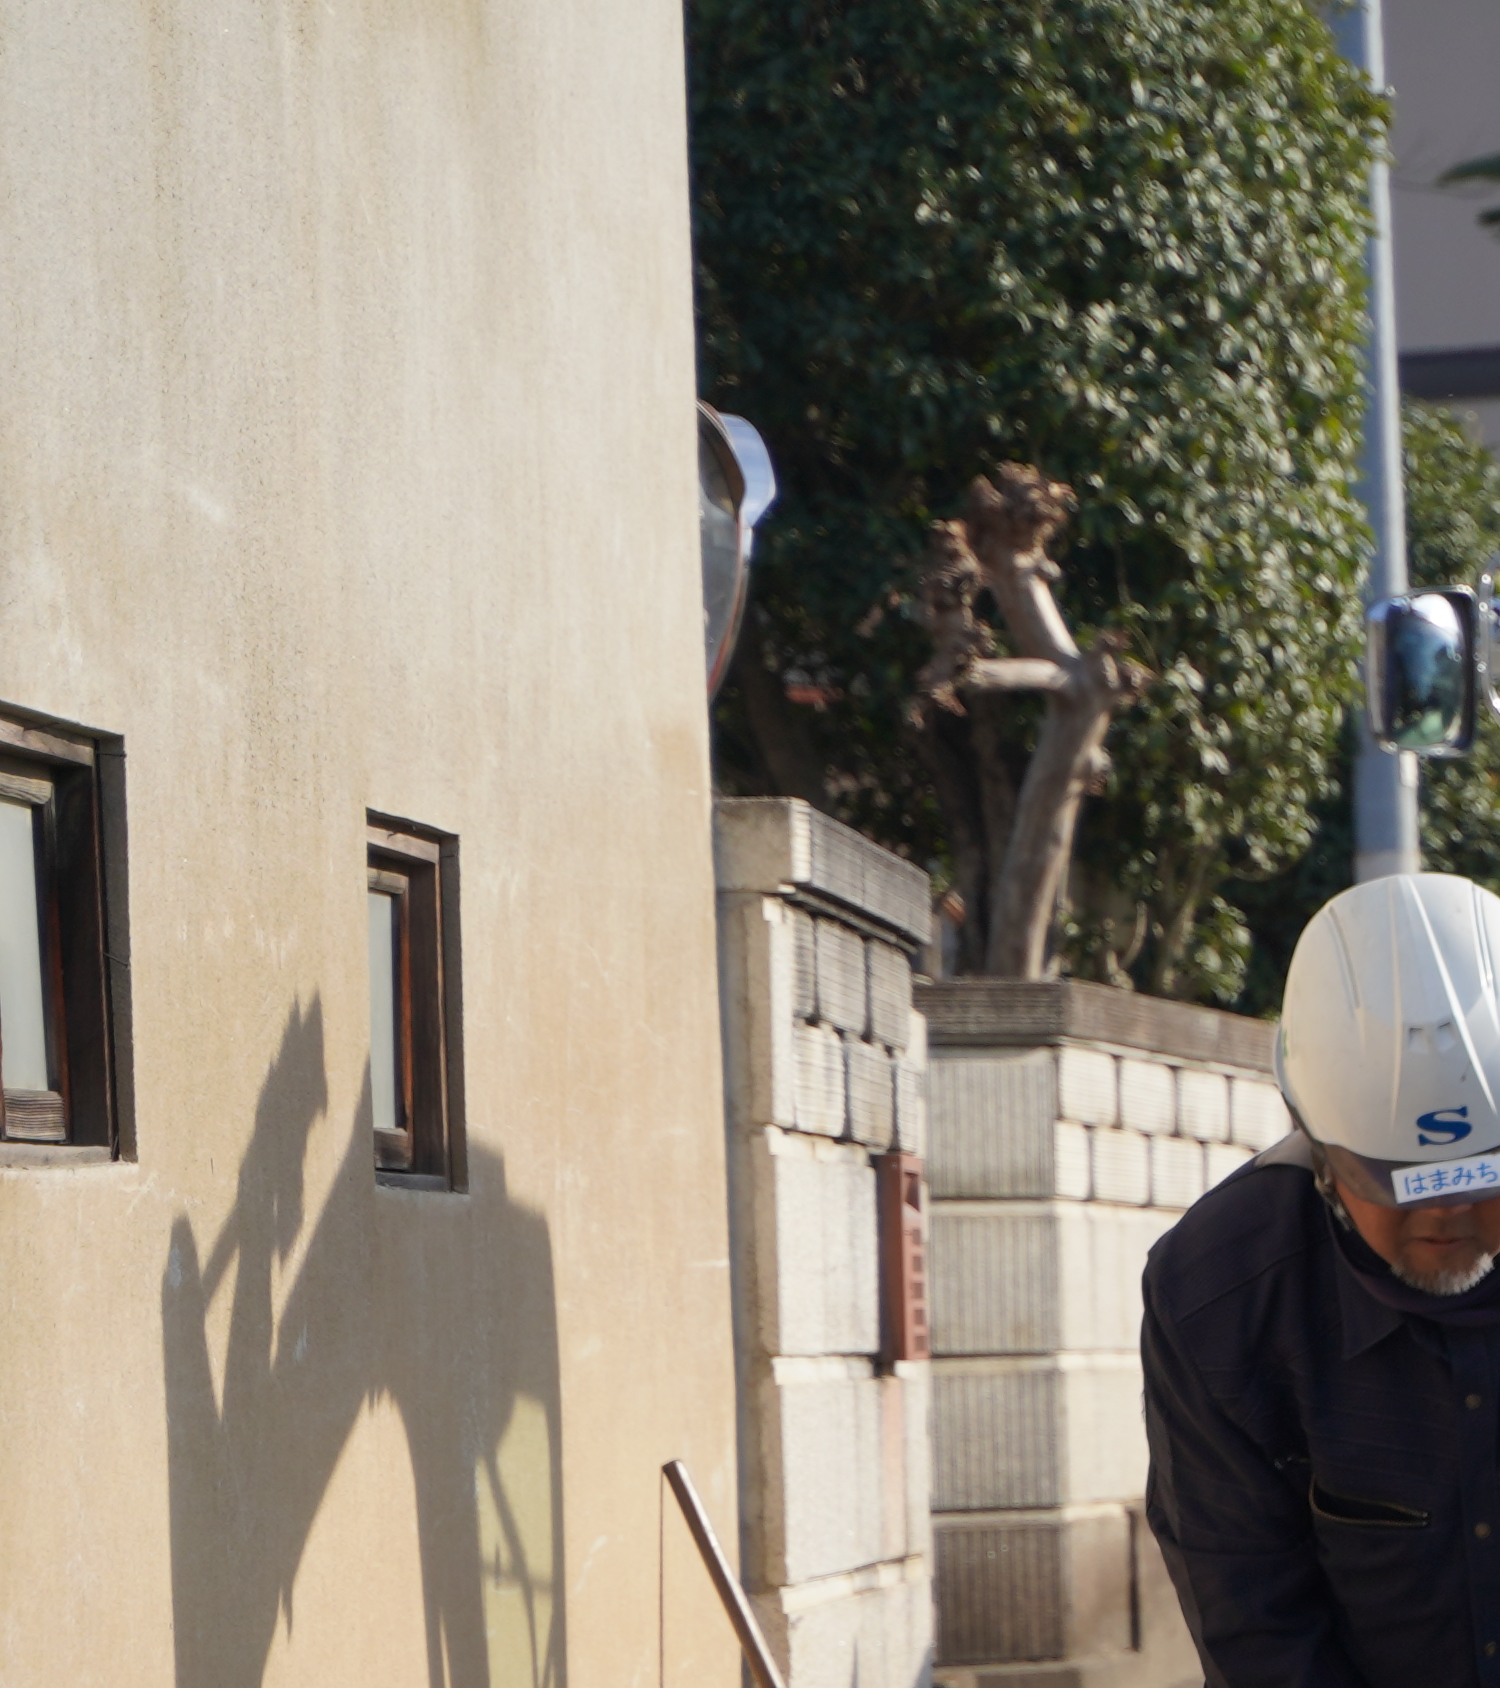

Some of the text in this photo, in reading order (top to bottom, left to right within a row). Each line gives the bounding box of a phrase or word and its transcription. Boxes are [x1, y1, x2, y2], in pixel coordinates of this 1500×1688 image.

[1416, 1105, 1473, 1147] S
[1403, 1159, 1500, 1197] はまみち
